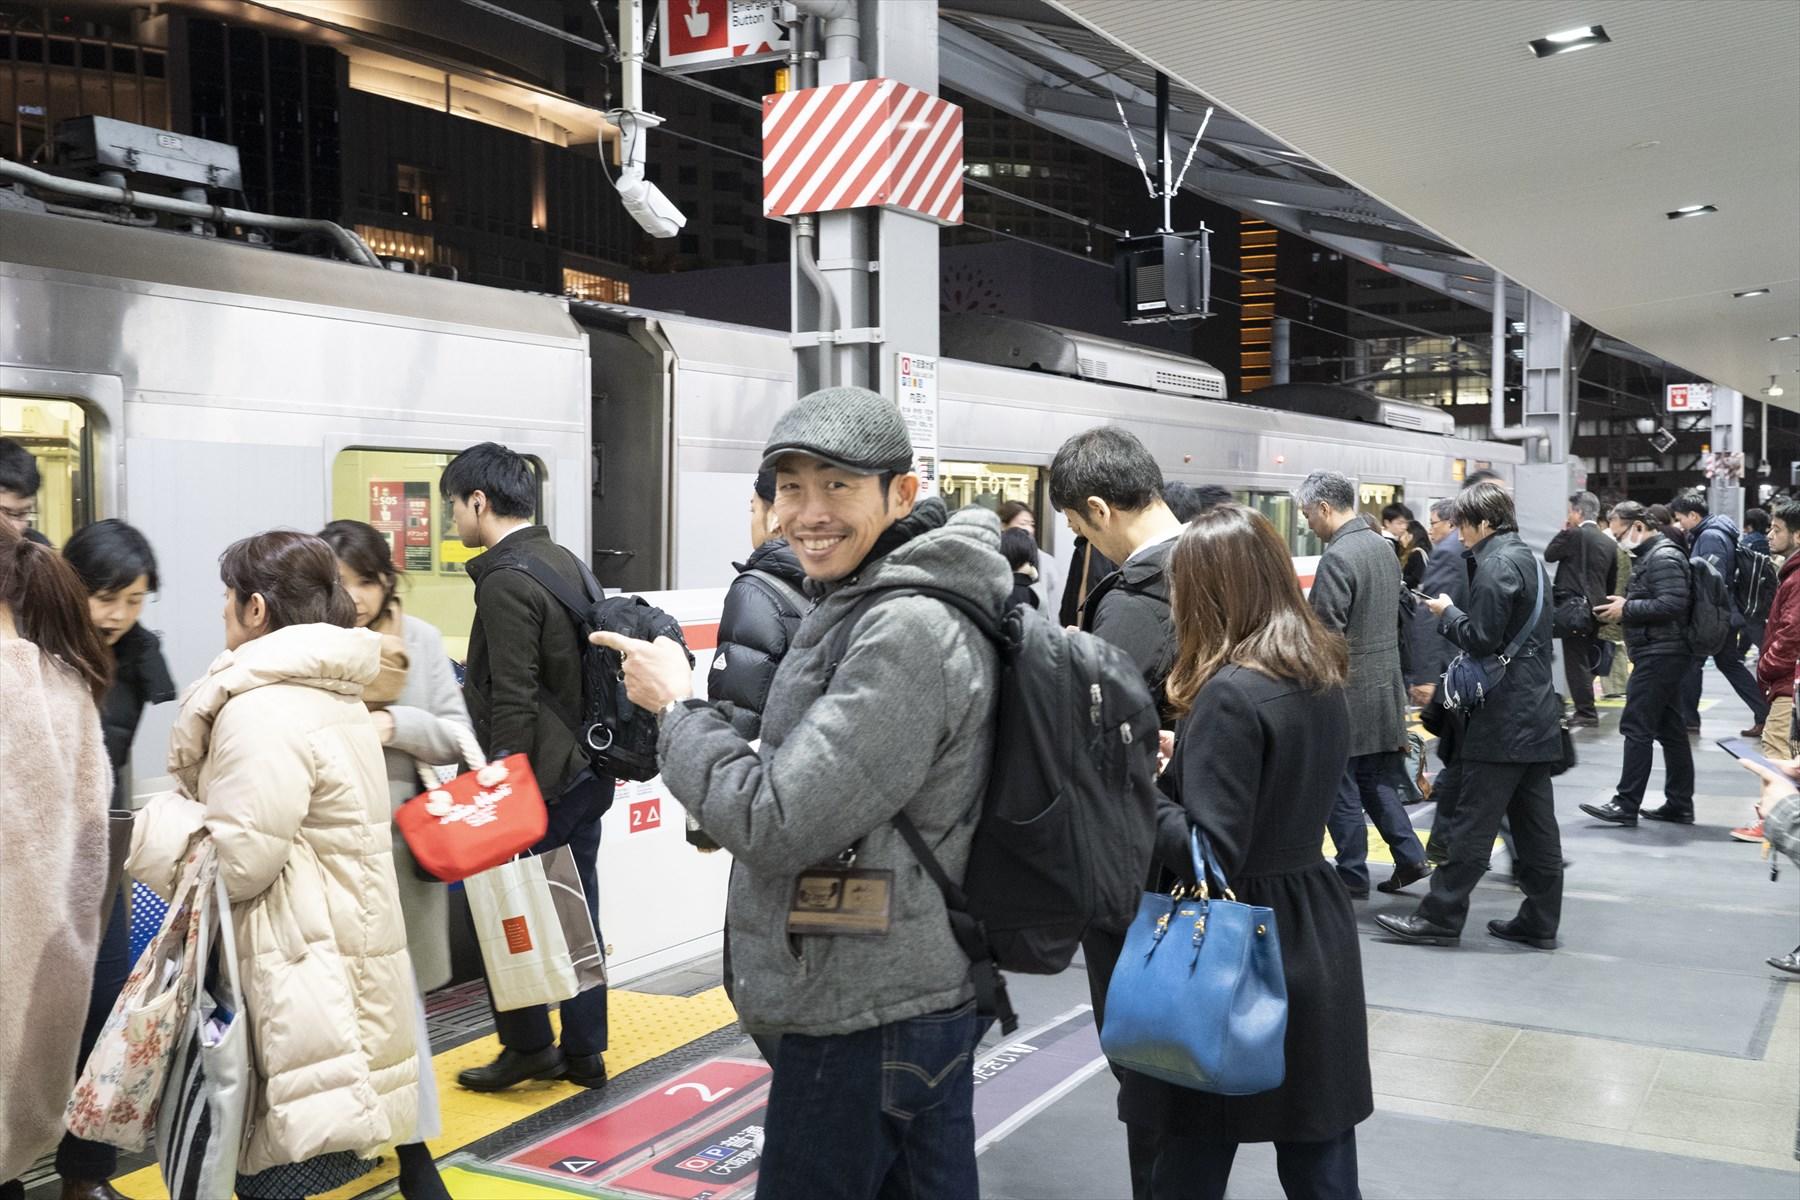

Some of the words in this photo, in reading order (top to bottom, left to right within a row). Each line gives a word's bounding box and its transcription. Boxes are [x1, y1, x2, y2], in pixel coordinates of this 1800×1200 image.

[732, 14, 765, 27] Button
[373, 486, 379, 498] 1
[380, 496, 398, 505] SOS
[632, 810, 643, 826] 2
[973, 1052, 1020, 1085] ださい
[664, 1083, 734, 1102] 2
